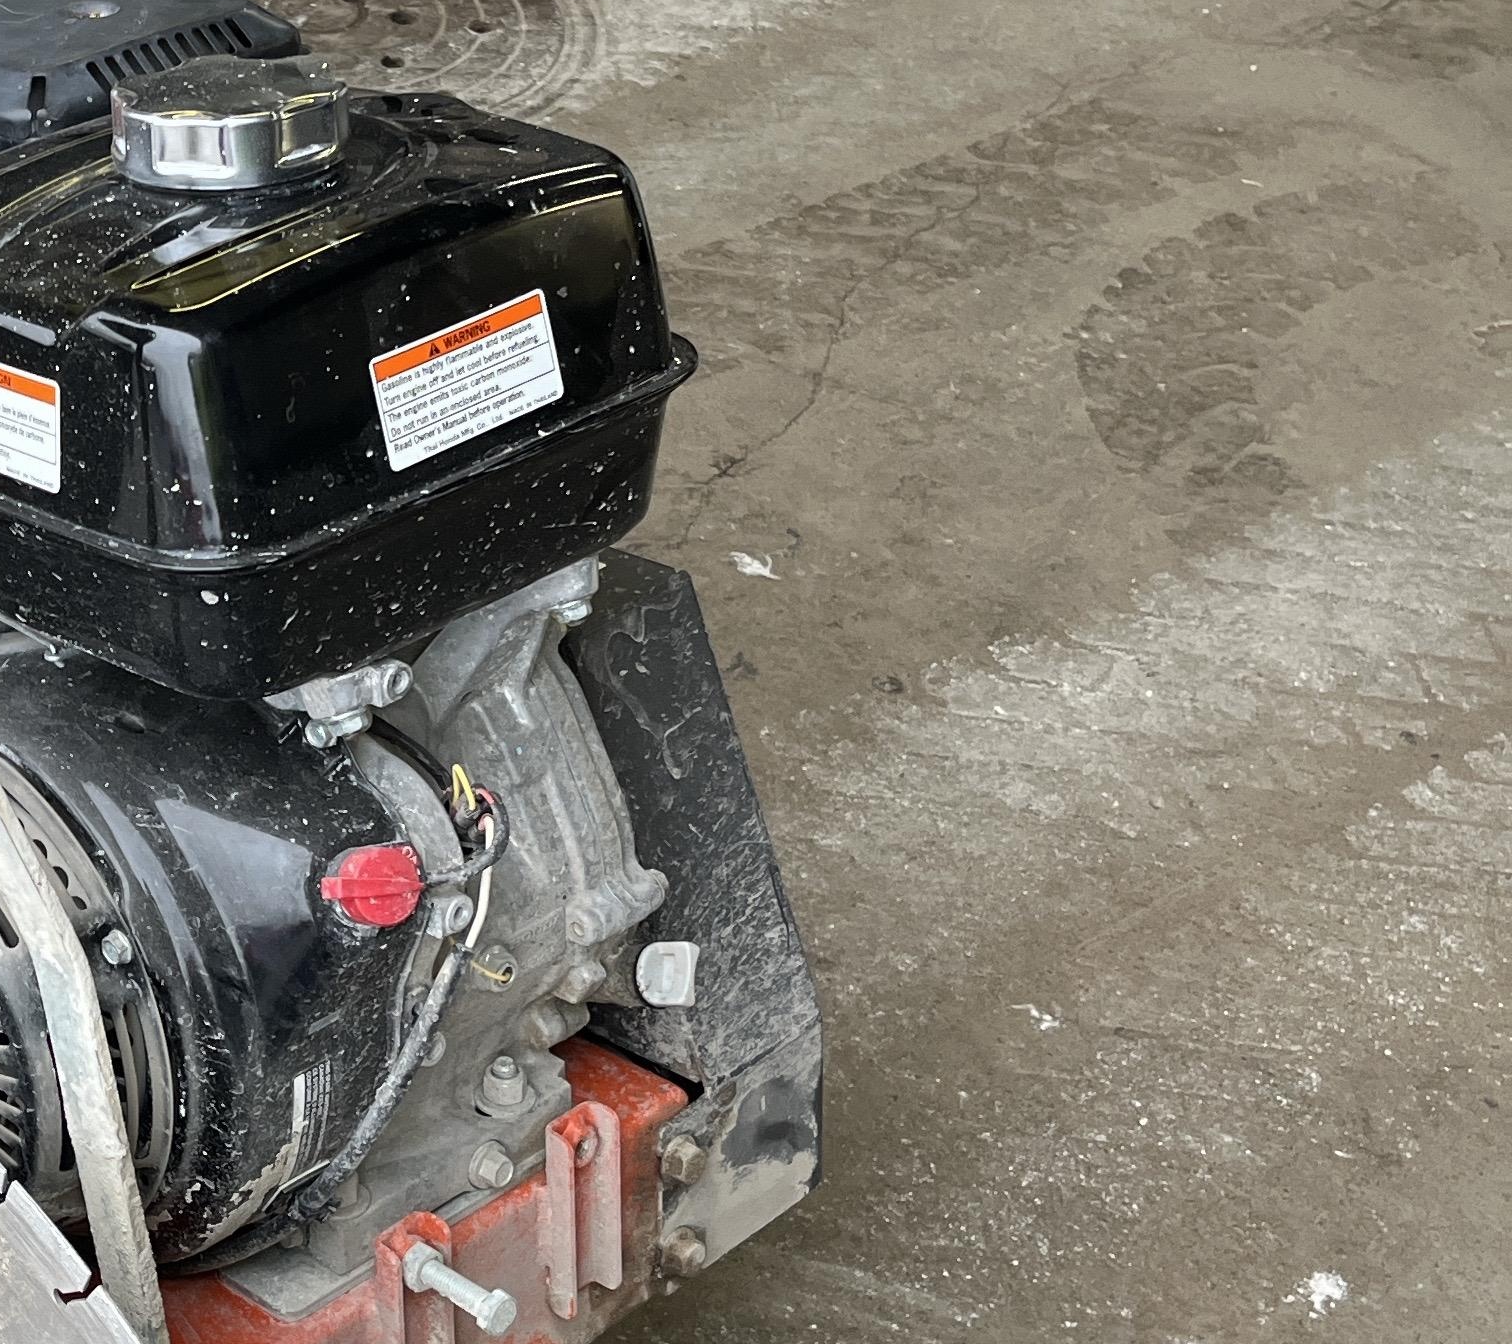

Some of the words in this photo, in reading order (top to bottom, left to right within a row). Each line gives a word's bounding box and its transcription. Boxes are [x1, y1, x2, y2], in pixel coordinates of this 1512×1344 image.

[442, 320, 490, 349] WARNING
[381, 374, 412, 392] Gasoline
[421, 360, 443, 374] highly
[445, 343, 483, 364] flammable
[485, 335, 498, 348] and
[383, 394, 401, 406] Turn
[402, 383, 426, 399] engine
[440, 369, 454, 382] and
[466, 357, 482, 371] cool
[482, 348, 506, 364] before
[387, 411, 401, 422] The
[403, 400, 427, 416] engine
[429, 391, 449, 405] emits
[470, 371, 495, 387] carbon
[390, 427, 401, 437] Do
[402, 420, 415, 431] not
[416, 415, 429, 425] run
[449, 390, 485, 410] enclosed
[393, 438, 412, 453] Read
[467, 404, 490, 420] before
